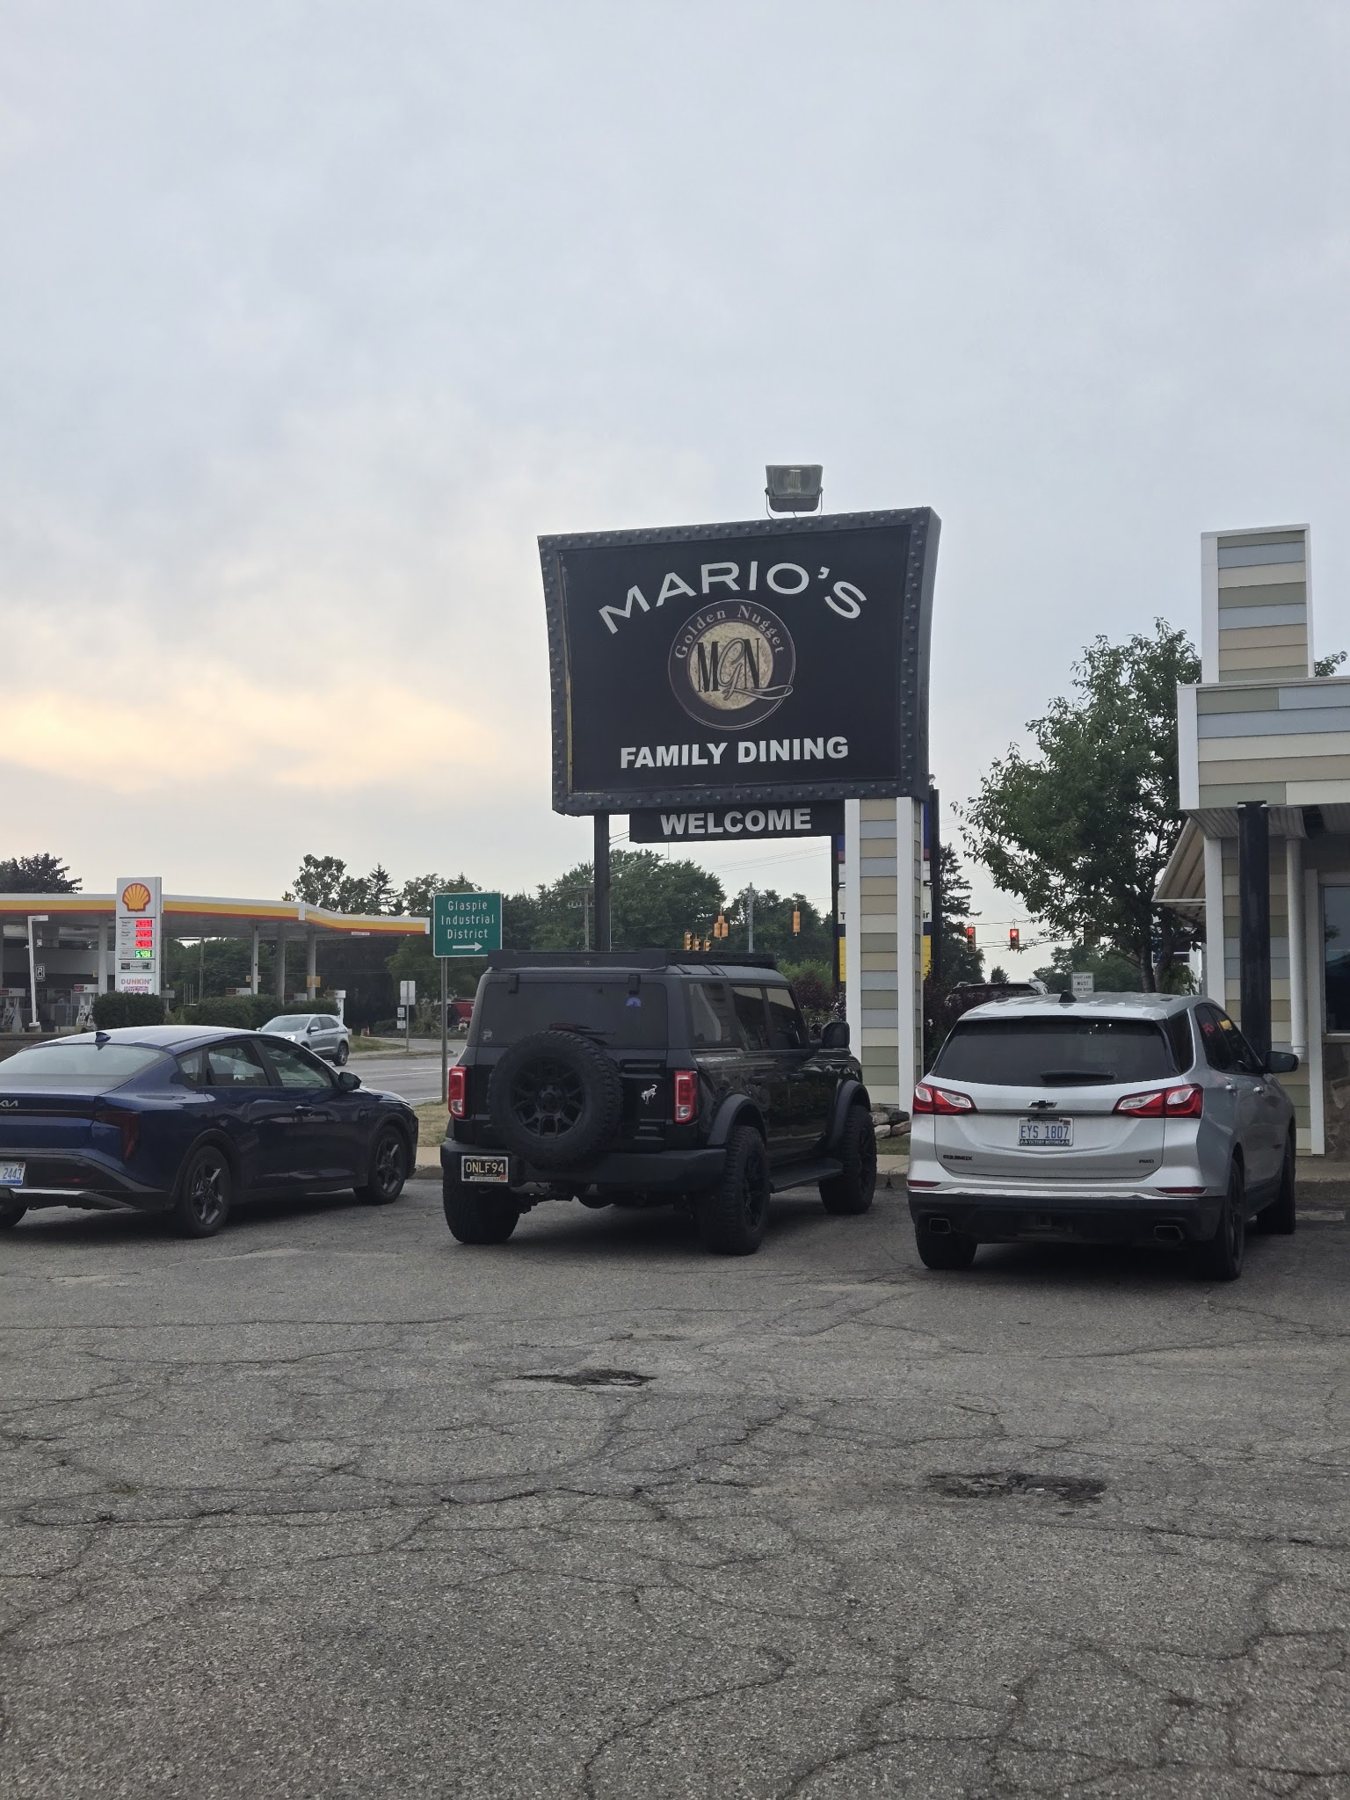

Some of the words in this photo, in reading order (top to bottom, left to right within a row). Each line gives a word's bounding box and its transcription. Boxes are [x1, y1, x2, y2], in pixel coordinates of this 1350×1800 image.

[598, 561, 867, 635] MARIO'S
[675, 610, 727, 659] Golden
[738, 605, 784, 654] Nugget
[620, 742, 728, 769] FAMILY
[737, 736, 849, 763] DINING
[660, 808, 812, 835] WELCOME
[447, 900, 488, 912] Glaspie
[441, 914, 494, 925] Industrial
[447, 928, 488, 939] District
[1020, 1125, 1039, 1139] EYS
[1044, 1125, 1069, 1139] 1807
